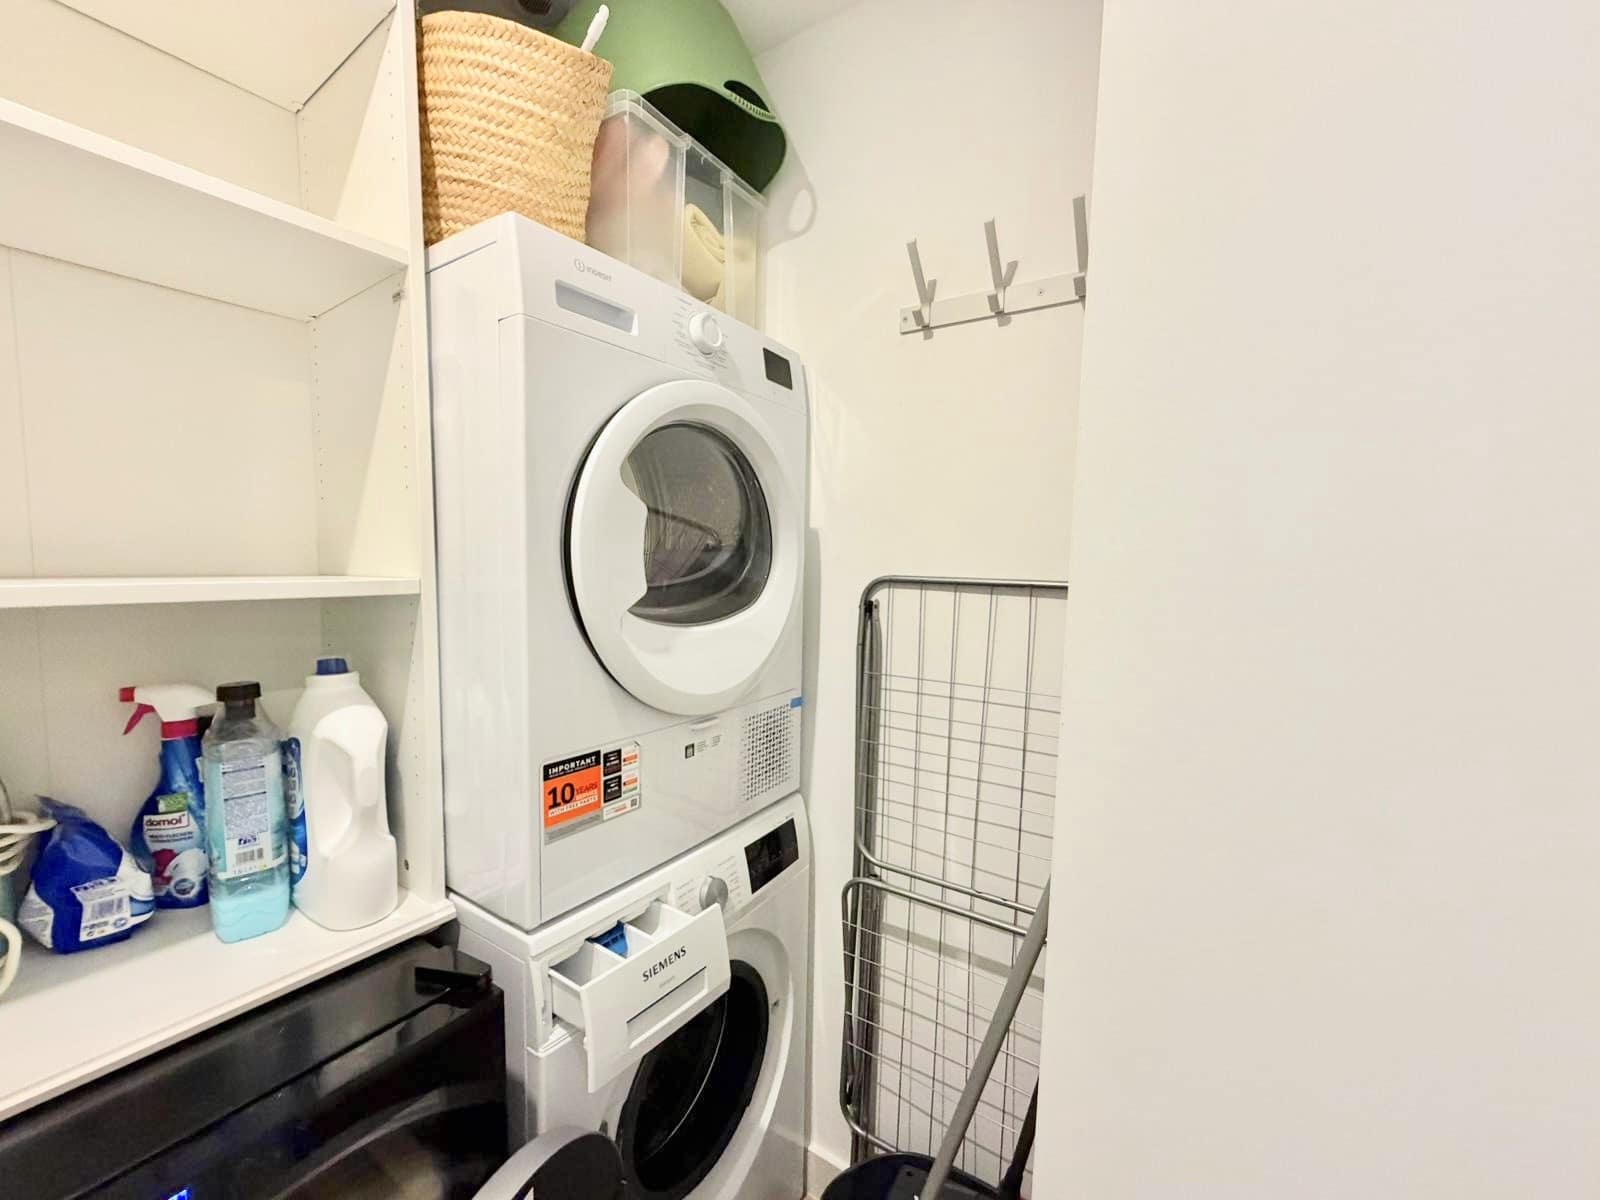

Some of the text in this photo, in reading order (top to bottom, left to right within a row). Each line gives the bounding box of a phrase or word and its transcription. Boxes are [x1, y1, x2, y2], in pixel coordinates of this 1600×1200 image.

[548, 756, 597, 775] IMPORTANT
[548, 783, 575, 810] 10
[576, 781, 598, 795] YEARS
[146, 816, 183, 827] domol
[642, 945, 687, 982] SIEMENS
